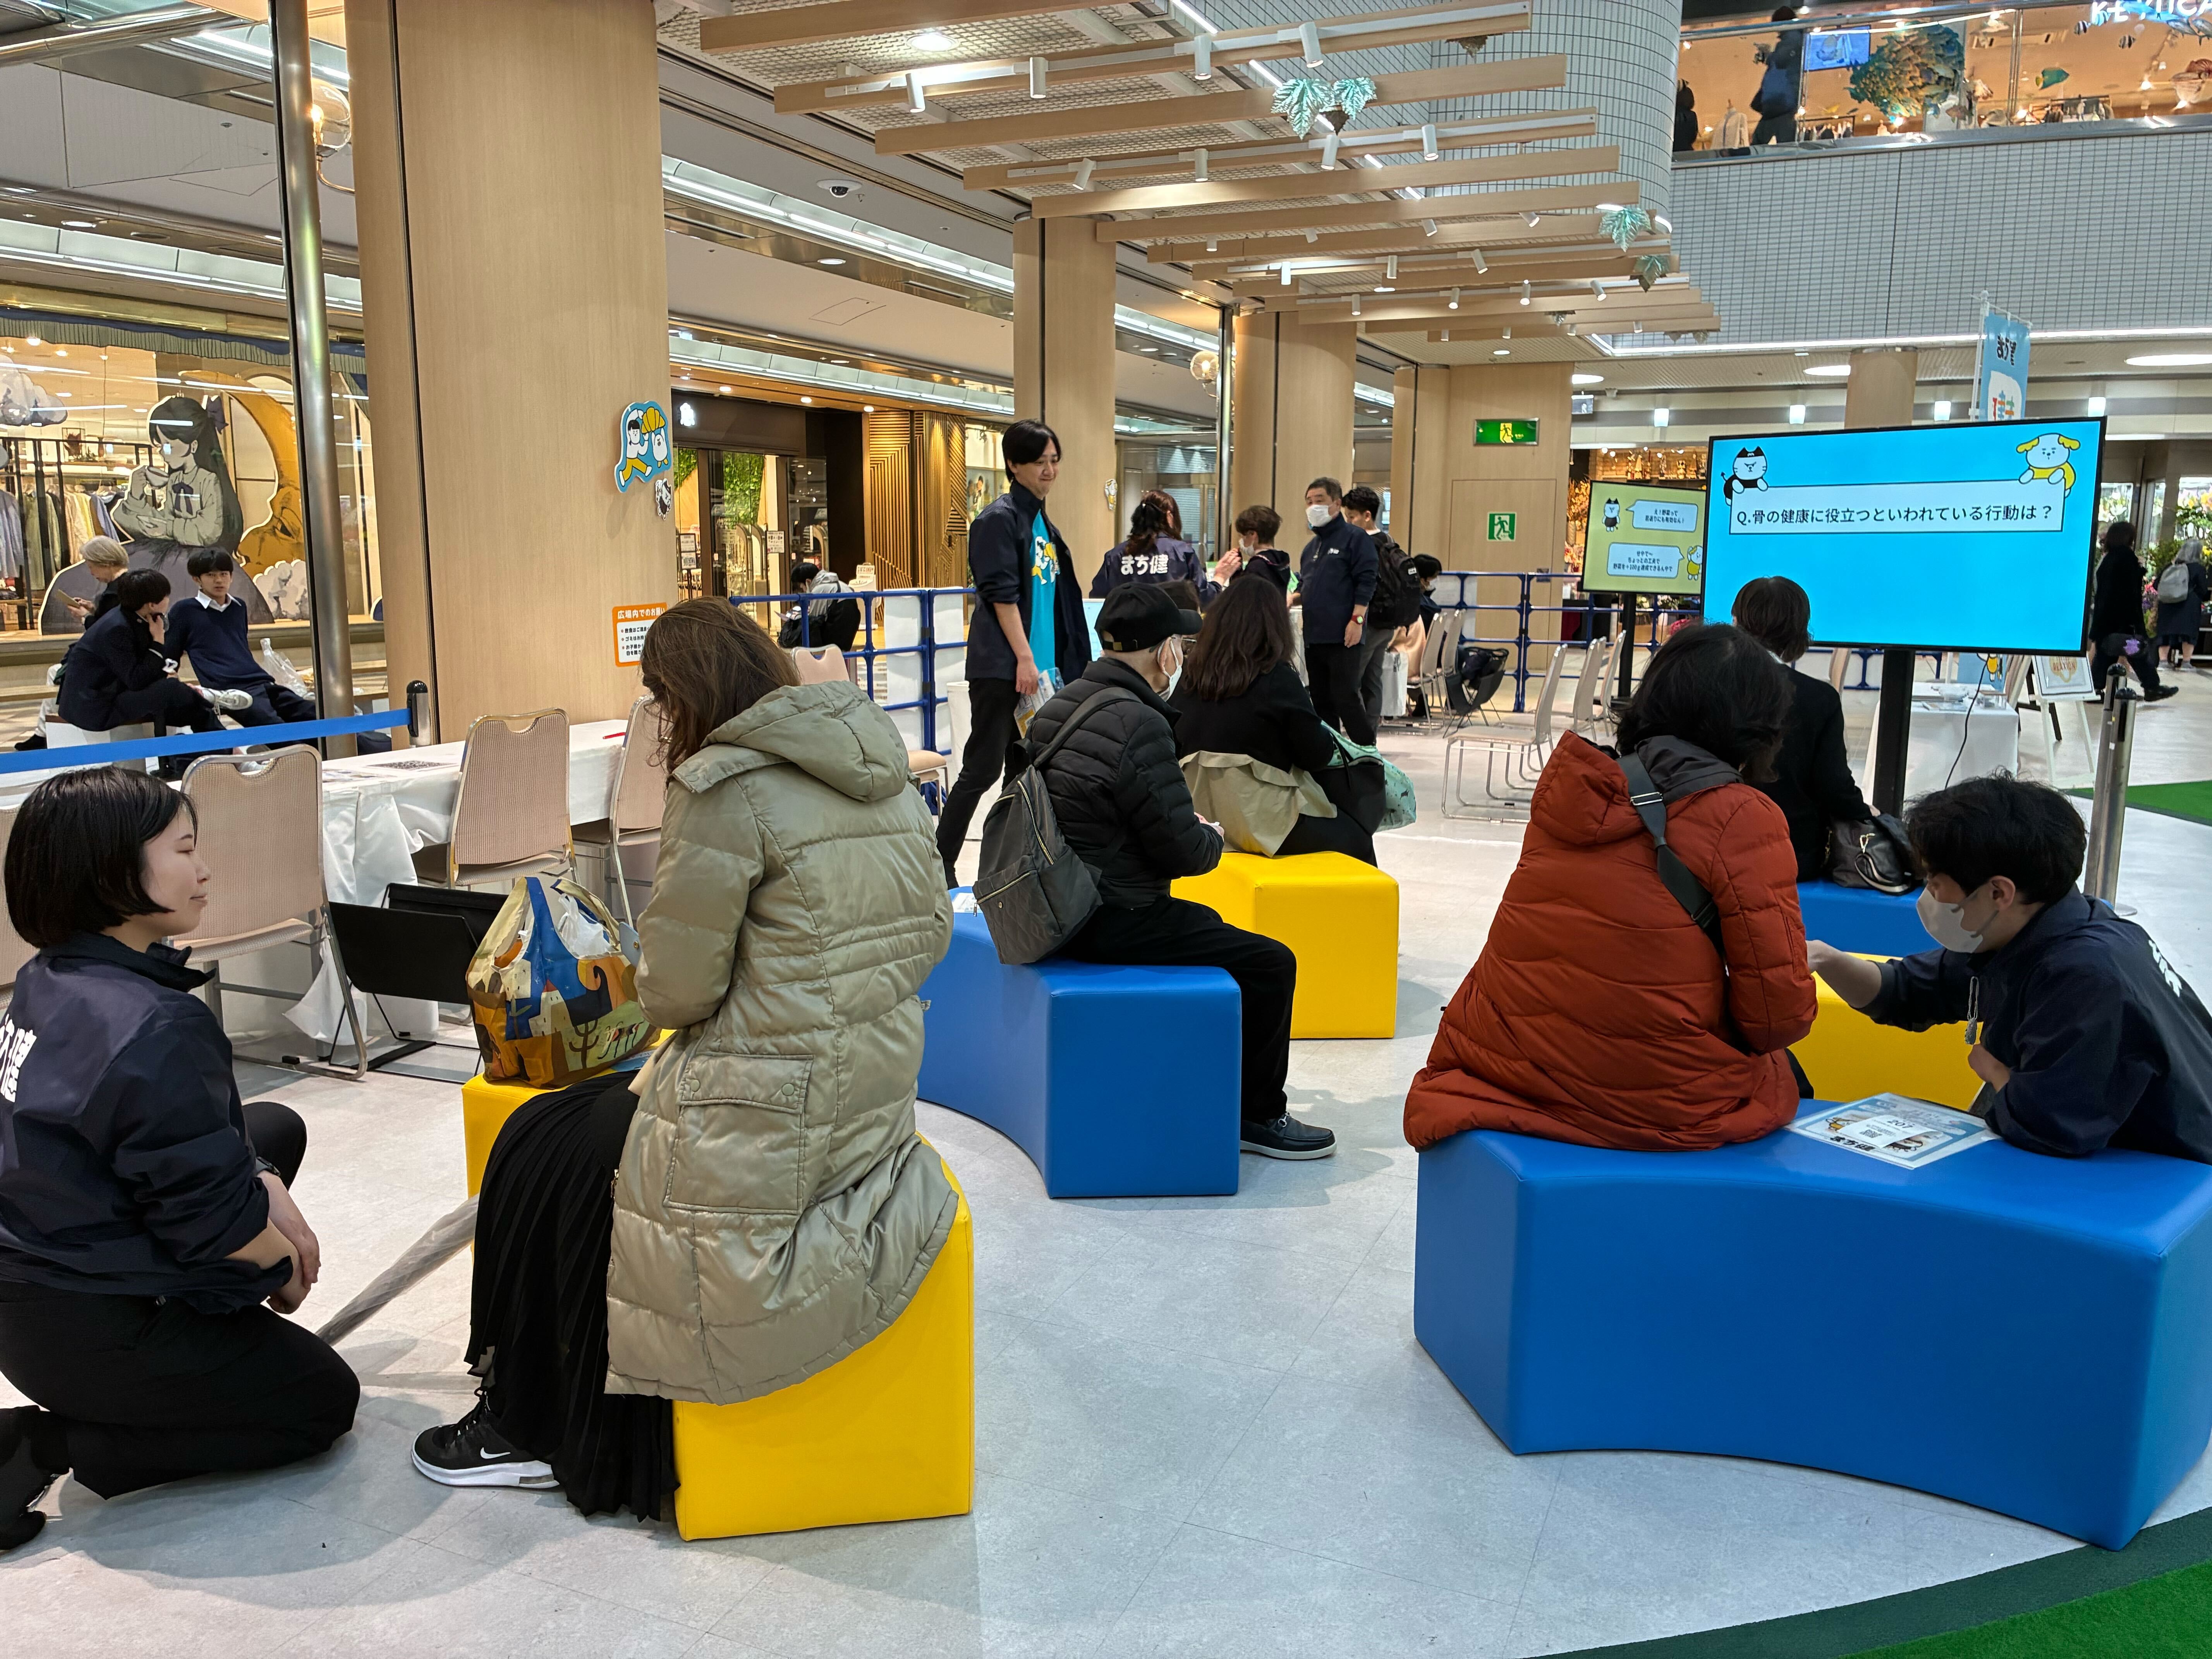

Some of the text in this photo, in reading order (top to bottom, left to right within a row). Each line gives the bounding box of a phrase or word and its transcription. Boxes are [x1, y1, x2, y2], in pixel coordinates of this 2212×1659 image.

[1737, 505, 2052, 526] Q.骨の健康に役立つといわれている行動は？
[1121, 554, 1169, 575] まち健
[618, 607, 665, 620] 広場内でのお願い
